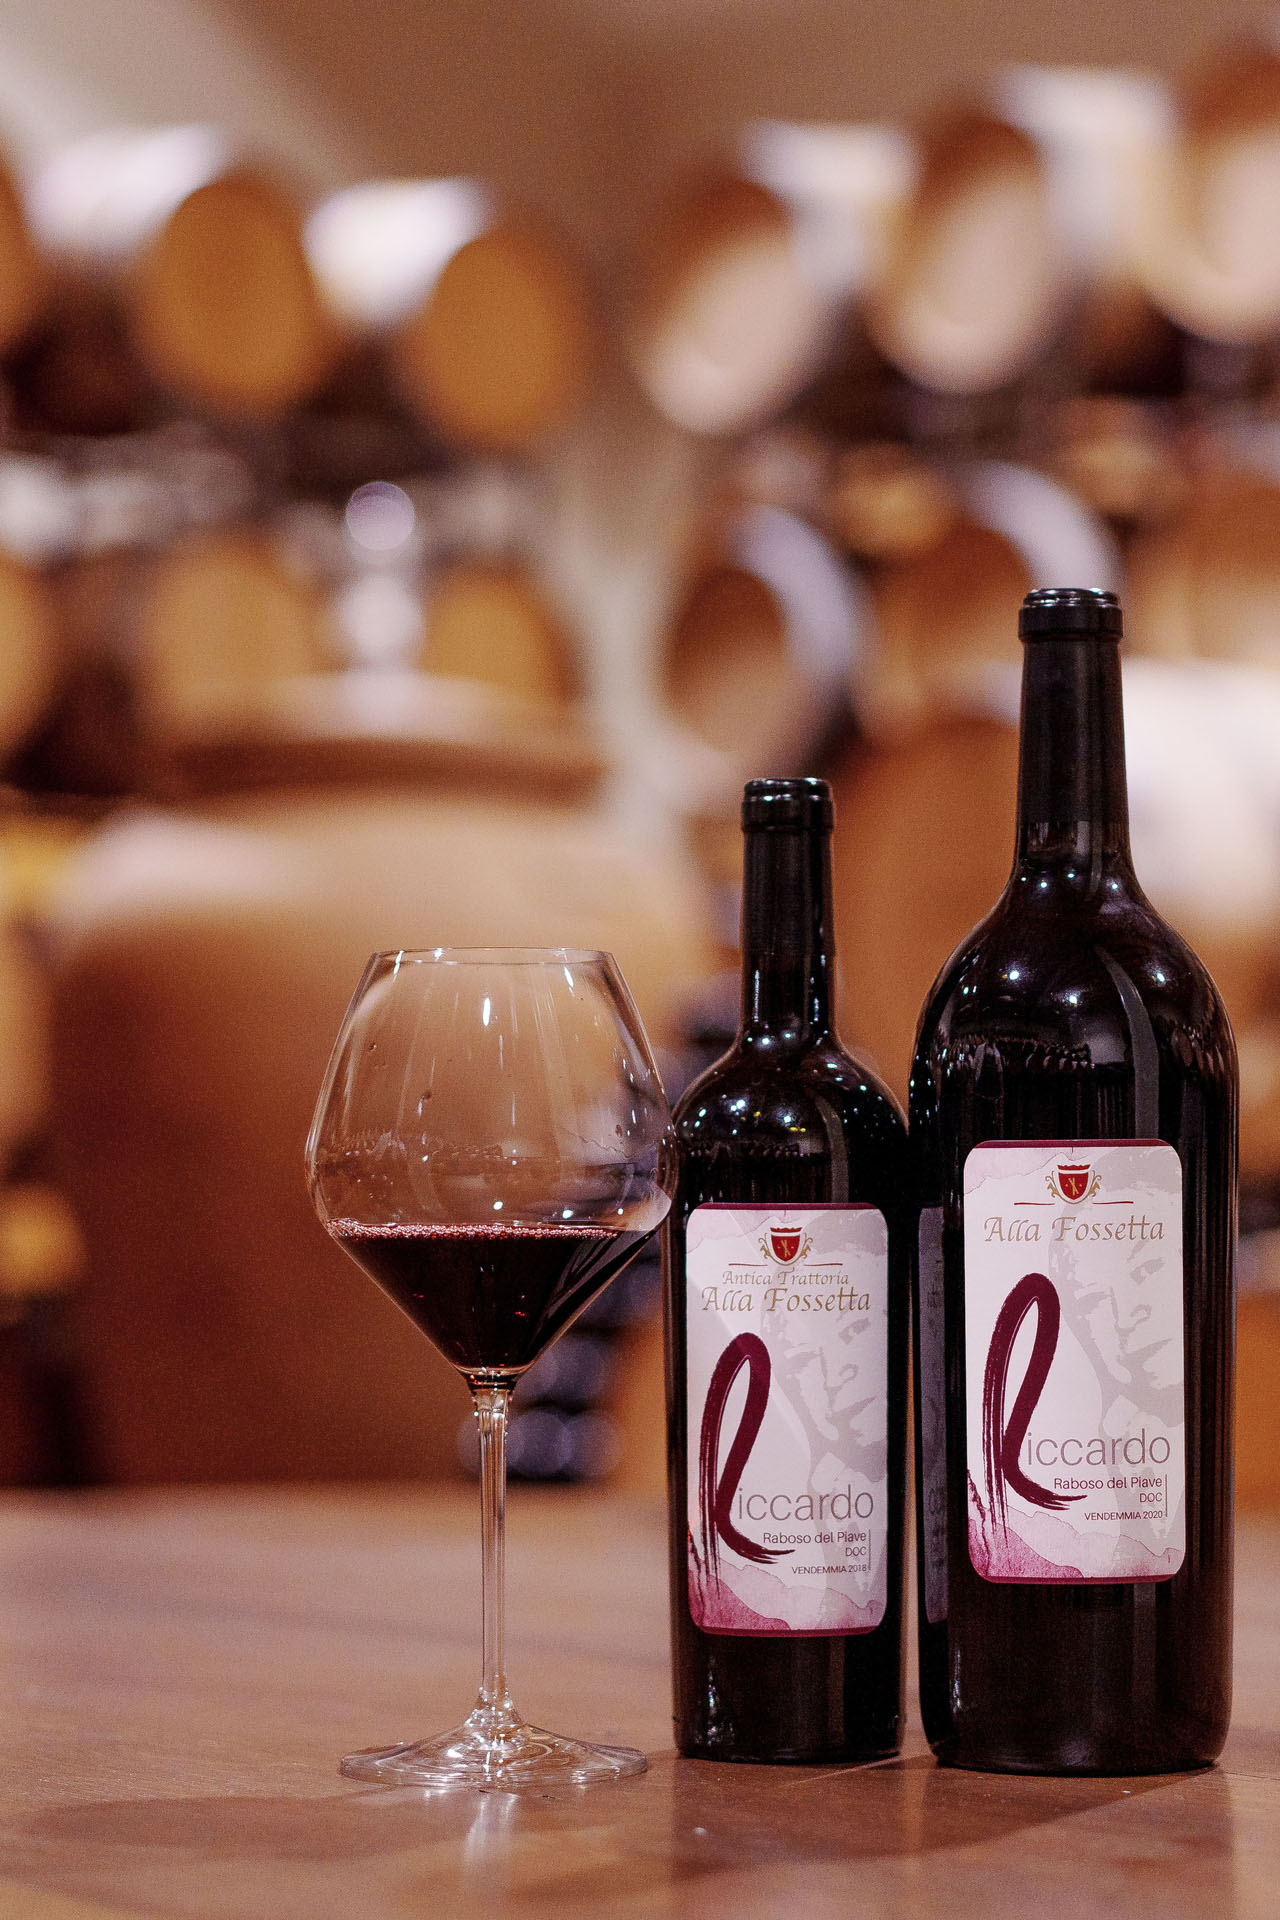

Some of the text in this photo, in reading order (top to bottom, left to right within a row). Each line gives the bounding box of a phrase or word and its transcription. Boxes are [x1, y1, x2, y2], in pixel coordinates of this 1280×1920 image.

[983, 1214, 1165, 1242] Alla Fossetta
[722, 1267, 849, 1286] Antica Trattoria
[701, 1286, 872, 1313] Alla Fossetta
[1053, 1476, 1163, 1490] Raboso del Piave
[1139, 1492, 1163, 1503] DOC
[1084, 1510, 1163, 1521] VENDEMMIA 2020
[762, 1531, 867, 1545] Raboso del Piave
[844, 1546, 867, 1557] DOC
[791, 1564, 867, 1575] VENDEMMIA 2018
